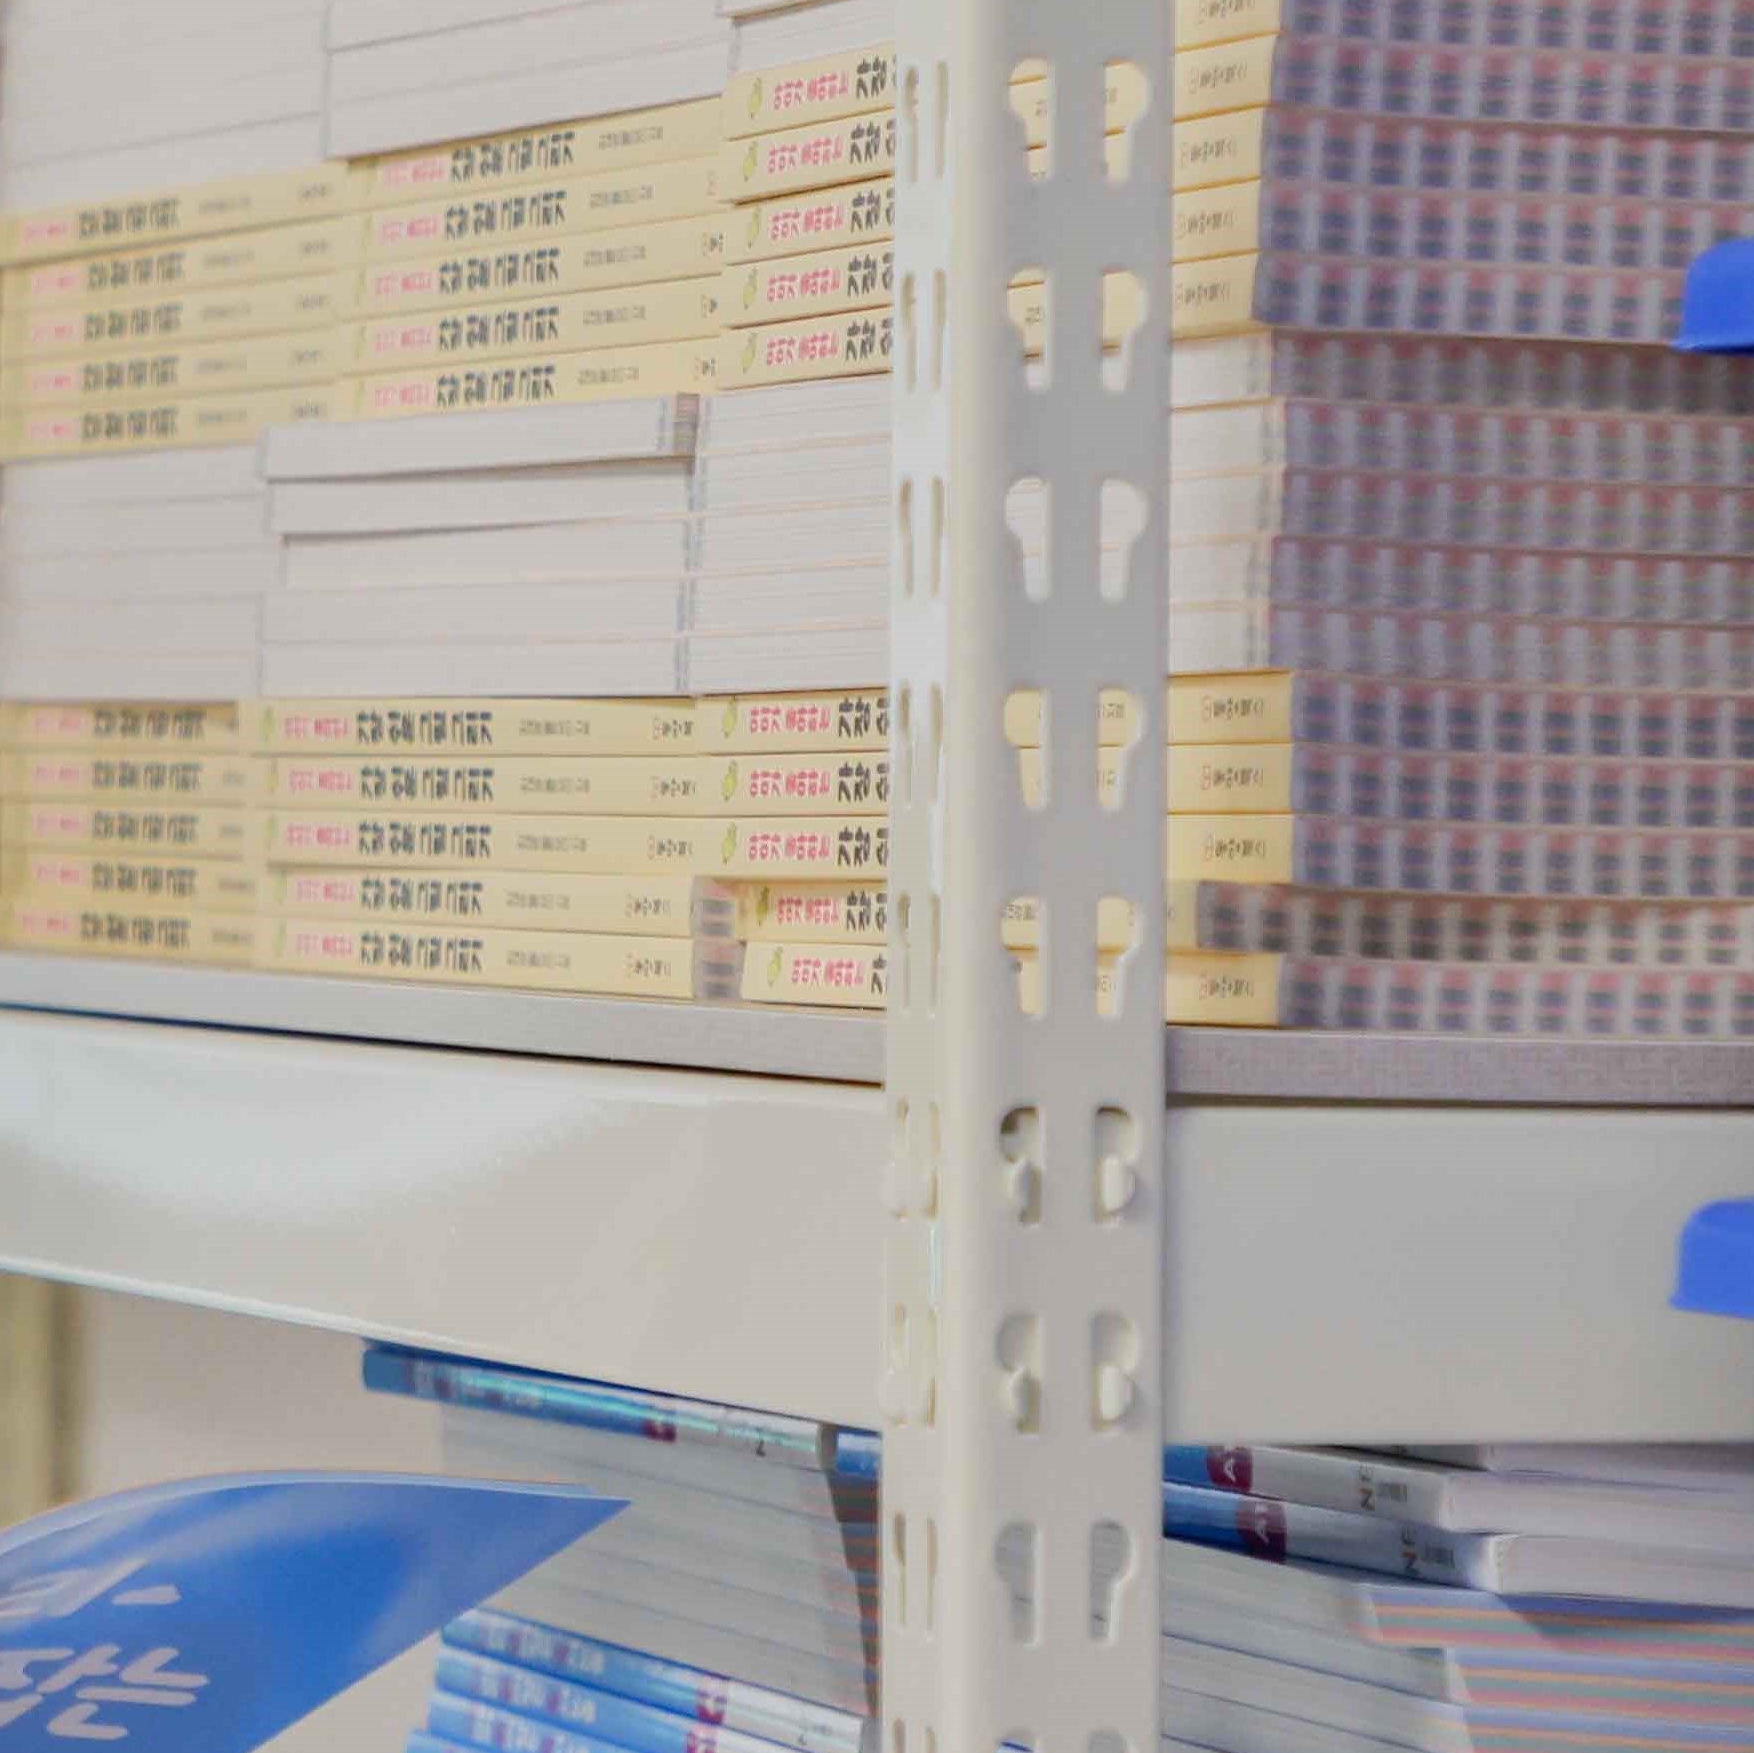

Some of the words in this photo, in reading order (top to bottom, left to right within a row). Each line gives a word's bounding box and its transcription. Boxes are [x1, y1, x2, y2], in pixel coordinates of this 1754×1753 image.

[856, 56, 886, 99] 가장
[850, 121, 880, 164] 가장
[851, 190, 880, 233] 가장
[847, 254, 877, 297] 가장
[846, 320, 875, 361] 가장
[750, 708, 781, 733] 아이가
[839, 697, 870, 738] 가장
[750, 770, 781, 796] 아이가
[839, 762, 870, 802] 가장
[749, 834, 781, 860] 아이가
[838, 826, 870, 866] 가장
[777, 897, 802, 925] 아이가
[847, 891, 871, 932] 가장
